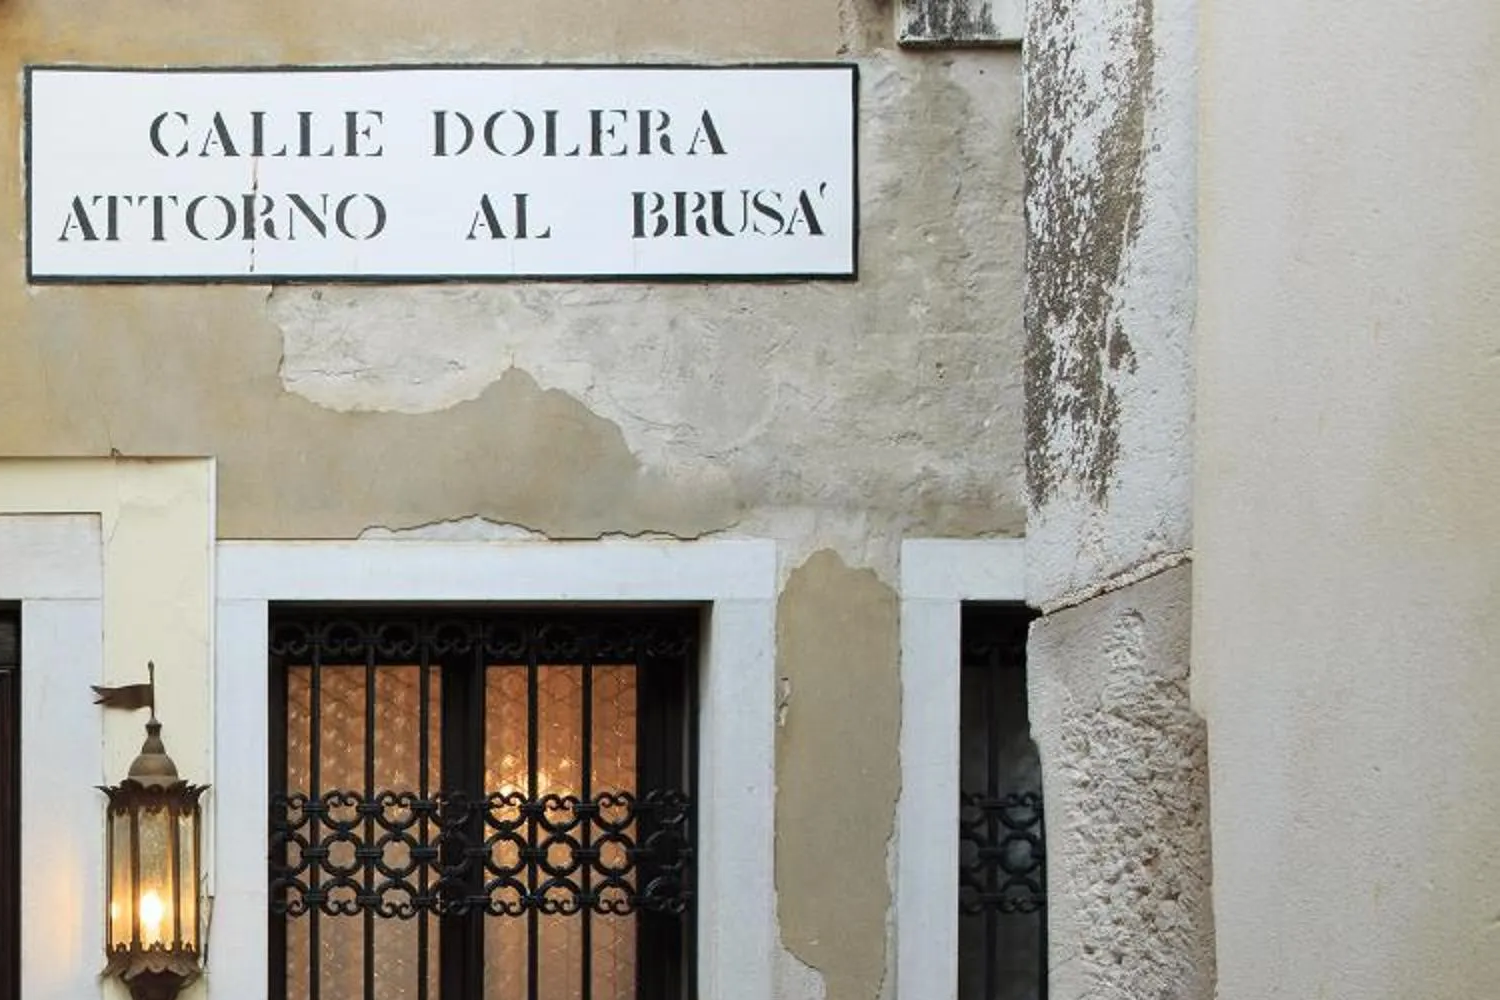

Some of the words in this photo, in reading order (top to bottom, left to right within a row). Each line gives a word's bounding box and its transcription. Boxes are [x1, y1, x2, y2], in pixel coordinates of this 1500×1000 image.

[149, 110, 385, 158] CALLE
[432, 109, 729, 157] DOLERA
[57, 193, 388, 243] ATTORNO
[466, 193, 552, 241] AL
